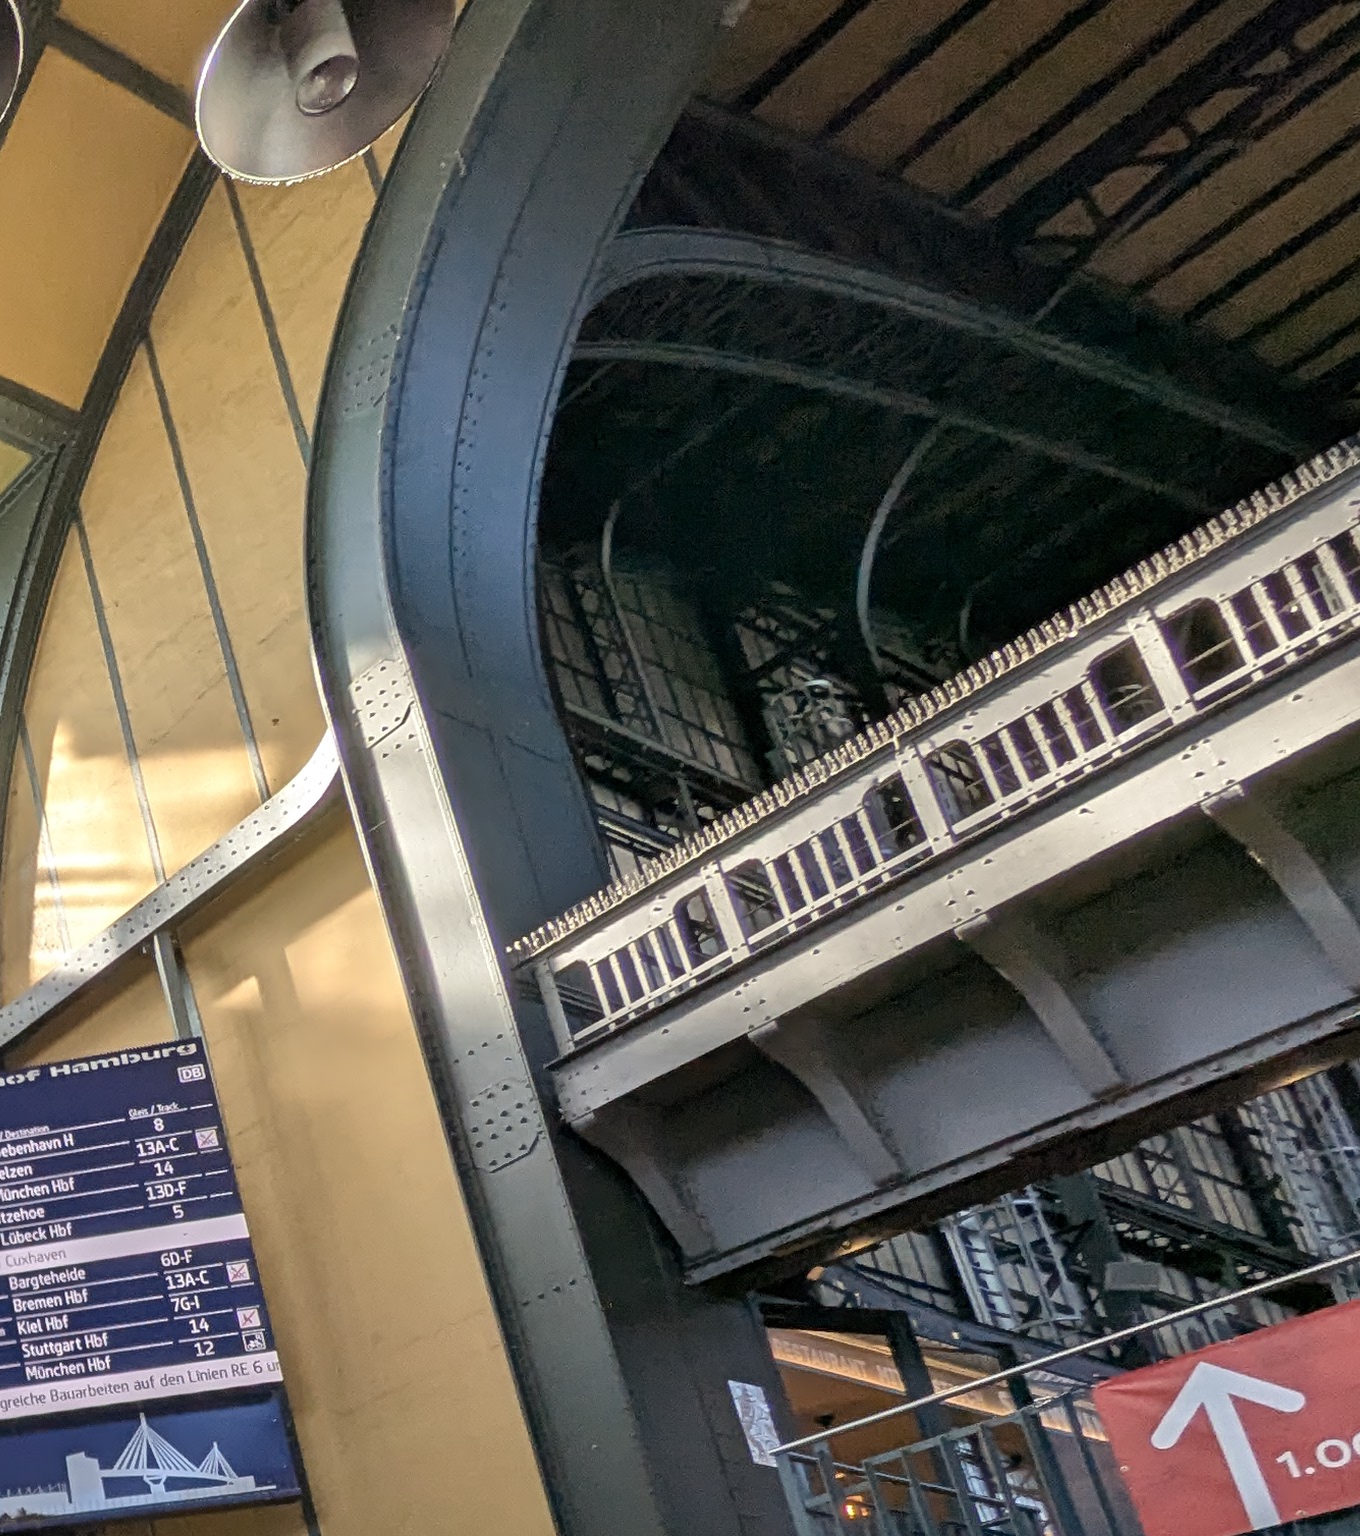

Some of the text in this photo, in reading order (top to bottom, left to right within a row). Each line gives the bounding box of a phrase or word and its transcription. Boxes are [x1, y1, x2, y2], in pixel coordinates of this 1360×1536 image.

[49, 1043, 197, 1078] Hamburg
[153, 1118, 165, 1132] 8
[65, 1133, 74, 1147] H
[136, 1137, 180, 1158] 13A-C
[153, 1161, 174, 1177] 14
[52, 1177, 75, 1194] Hbf
[146, 1181, 187, 1201] 13D-F
[173, 1204, 184, 1219] 5
[0, 1222, 73, 1247] Lübeck Hbf
[5, 1249, 67, 1268] Cuxhaven
[160, 1249, 193, 1268] 6D-F
[8, 1267, 86, 1291] Bargteheide
[165, 1269, 210, 1291] 13A-C
[12, 1288, 88, 1313] Bremen Hbf
[170, 1294, 200, 1312] 7G-I
[17, 1315, 68, 1337] Kiel Hbf
[188, 1318, 209, 1334] 14
[21, 1332, 108, 1360] Stuttgart Hbf
[194, 1340, 215, 1357] 12
[25, 1355, 111, 1383] München Hbf
[50, 1383, 130, 1403] Bauarbeiten
[134, 1377, 156, 1391] auf
[160, 1373, 185, 1387] den
[188, 1366, 228, 1383] Linien
[231, 1363, 248, 1377] RE
[253, 1360, 263, 1374] 6
